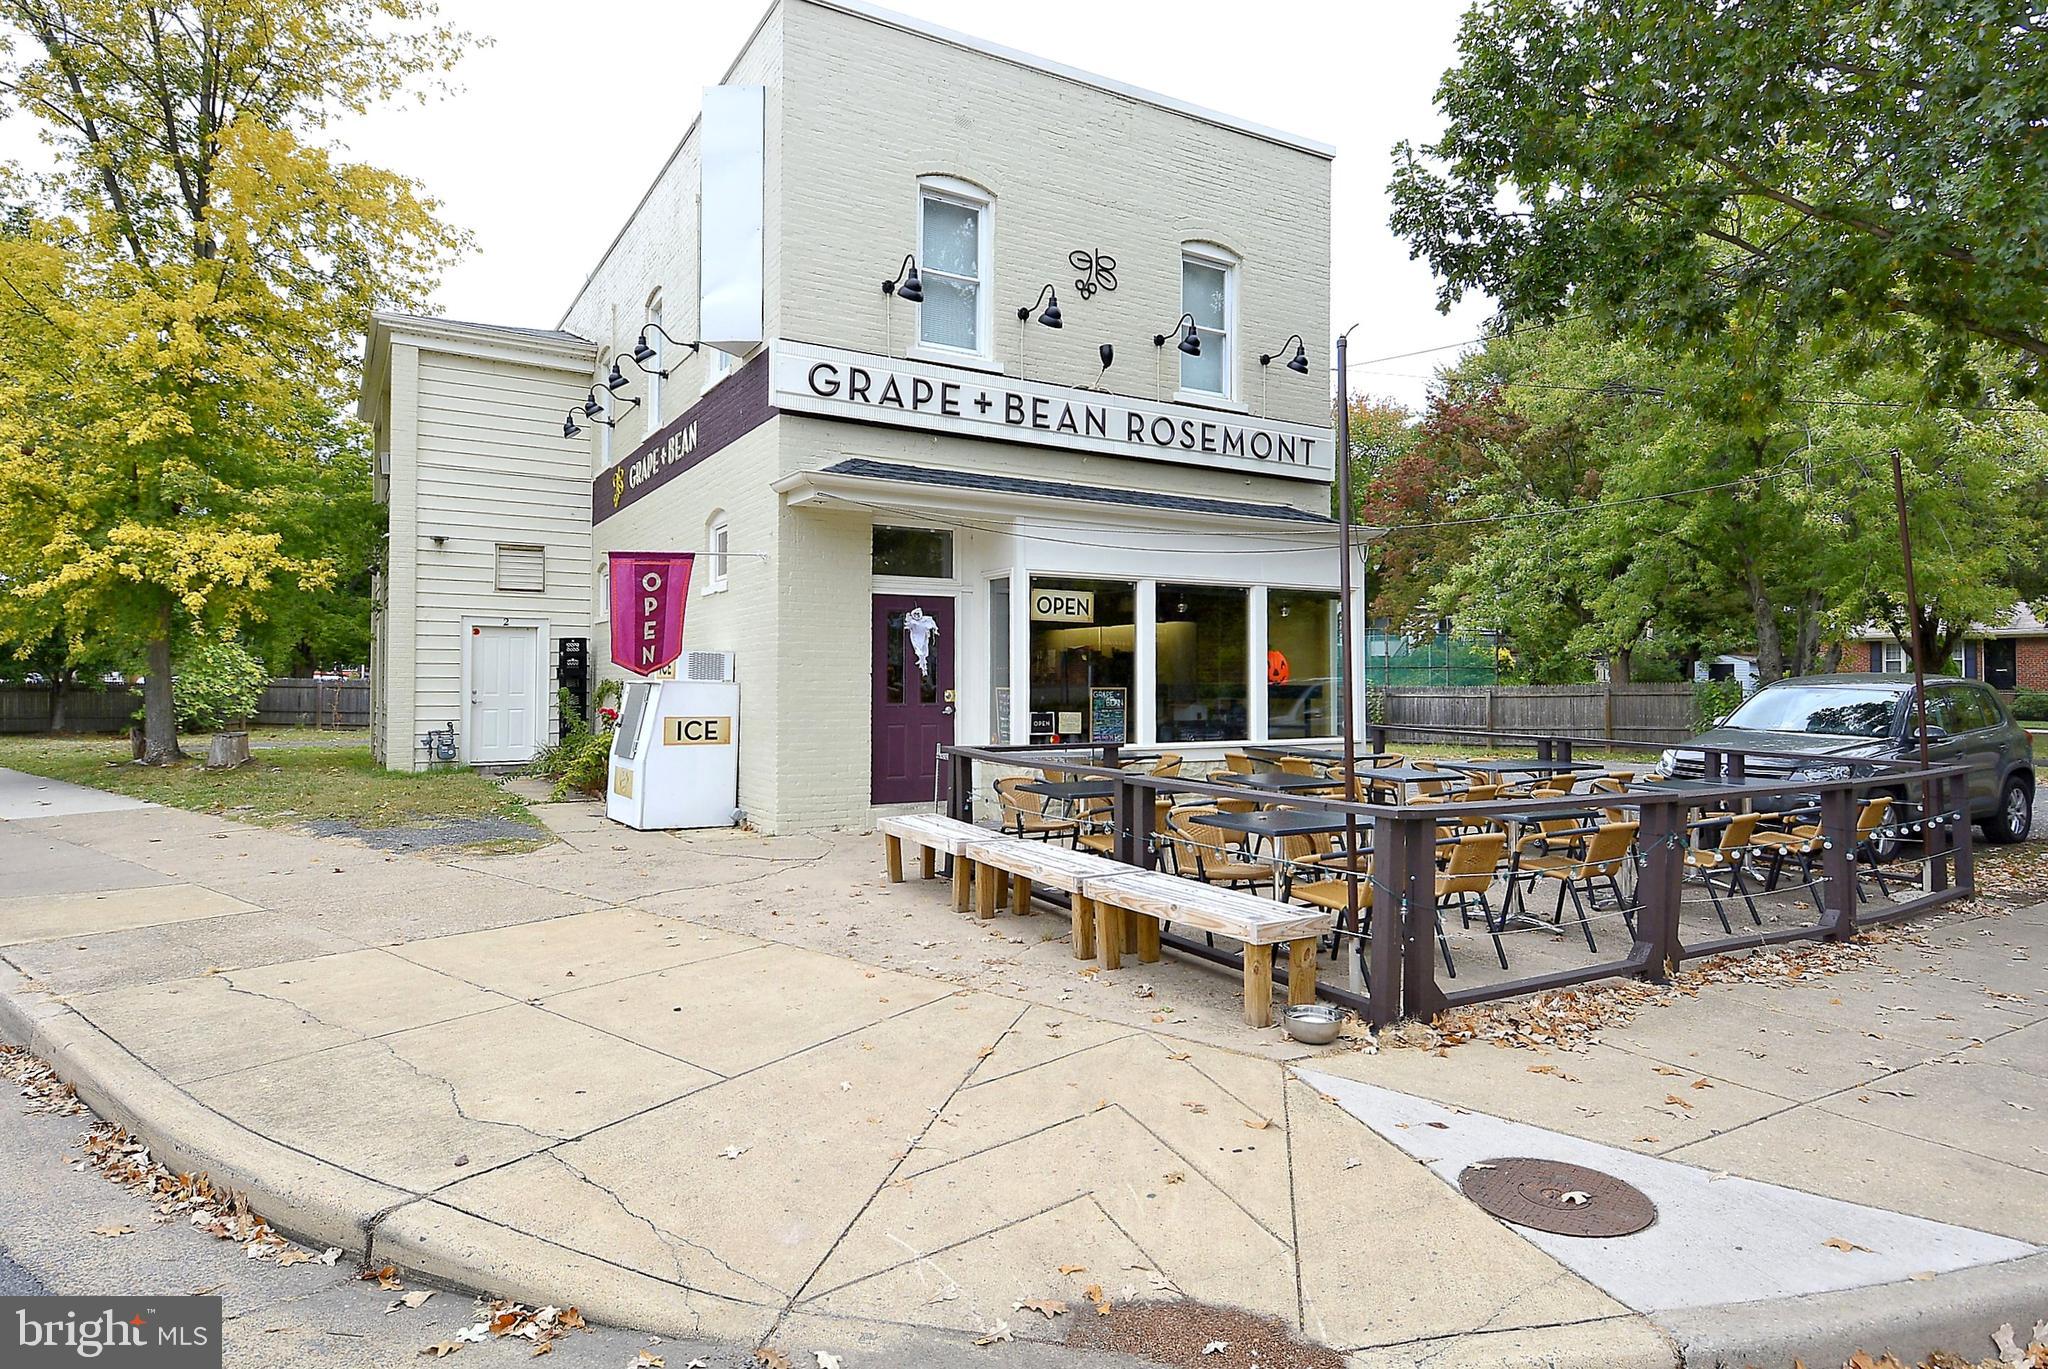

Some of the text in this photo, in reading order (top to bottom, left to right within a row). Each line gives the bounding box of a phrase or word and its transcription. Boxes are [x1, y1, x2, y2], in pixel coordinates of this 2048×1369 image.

[1126, 412, 1317, 466] ROSEMONT
[1036, 595, 1089, 616] OPEN
[503, 617, 510, 626] 2
[642, 572, 661, 665] OPEN
[676, 719, 719, 741] ICE
